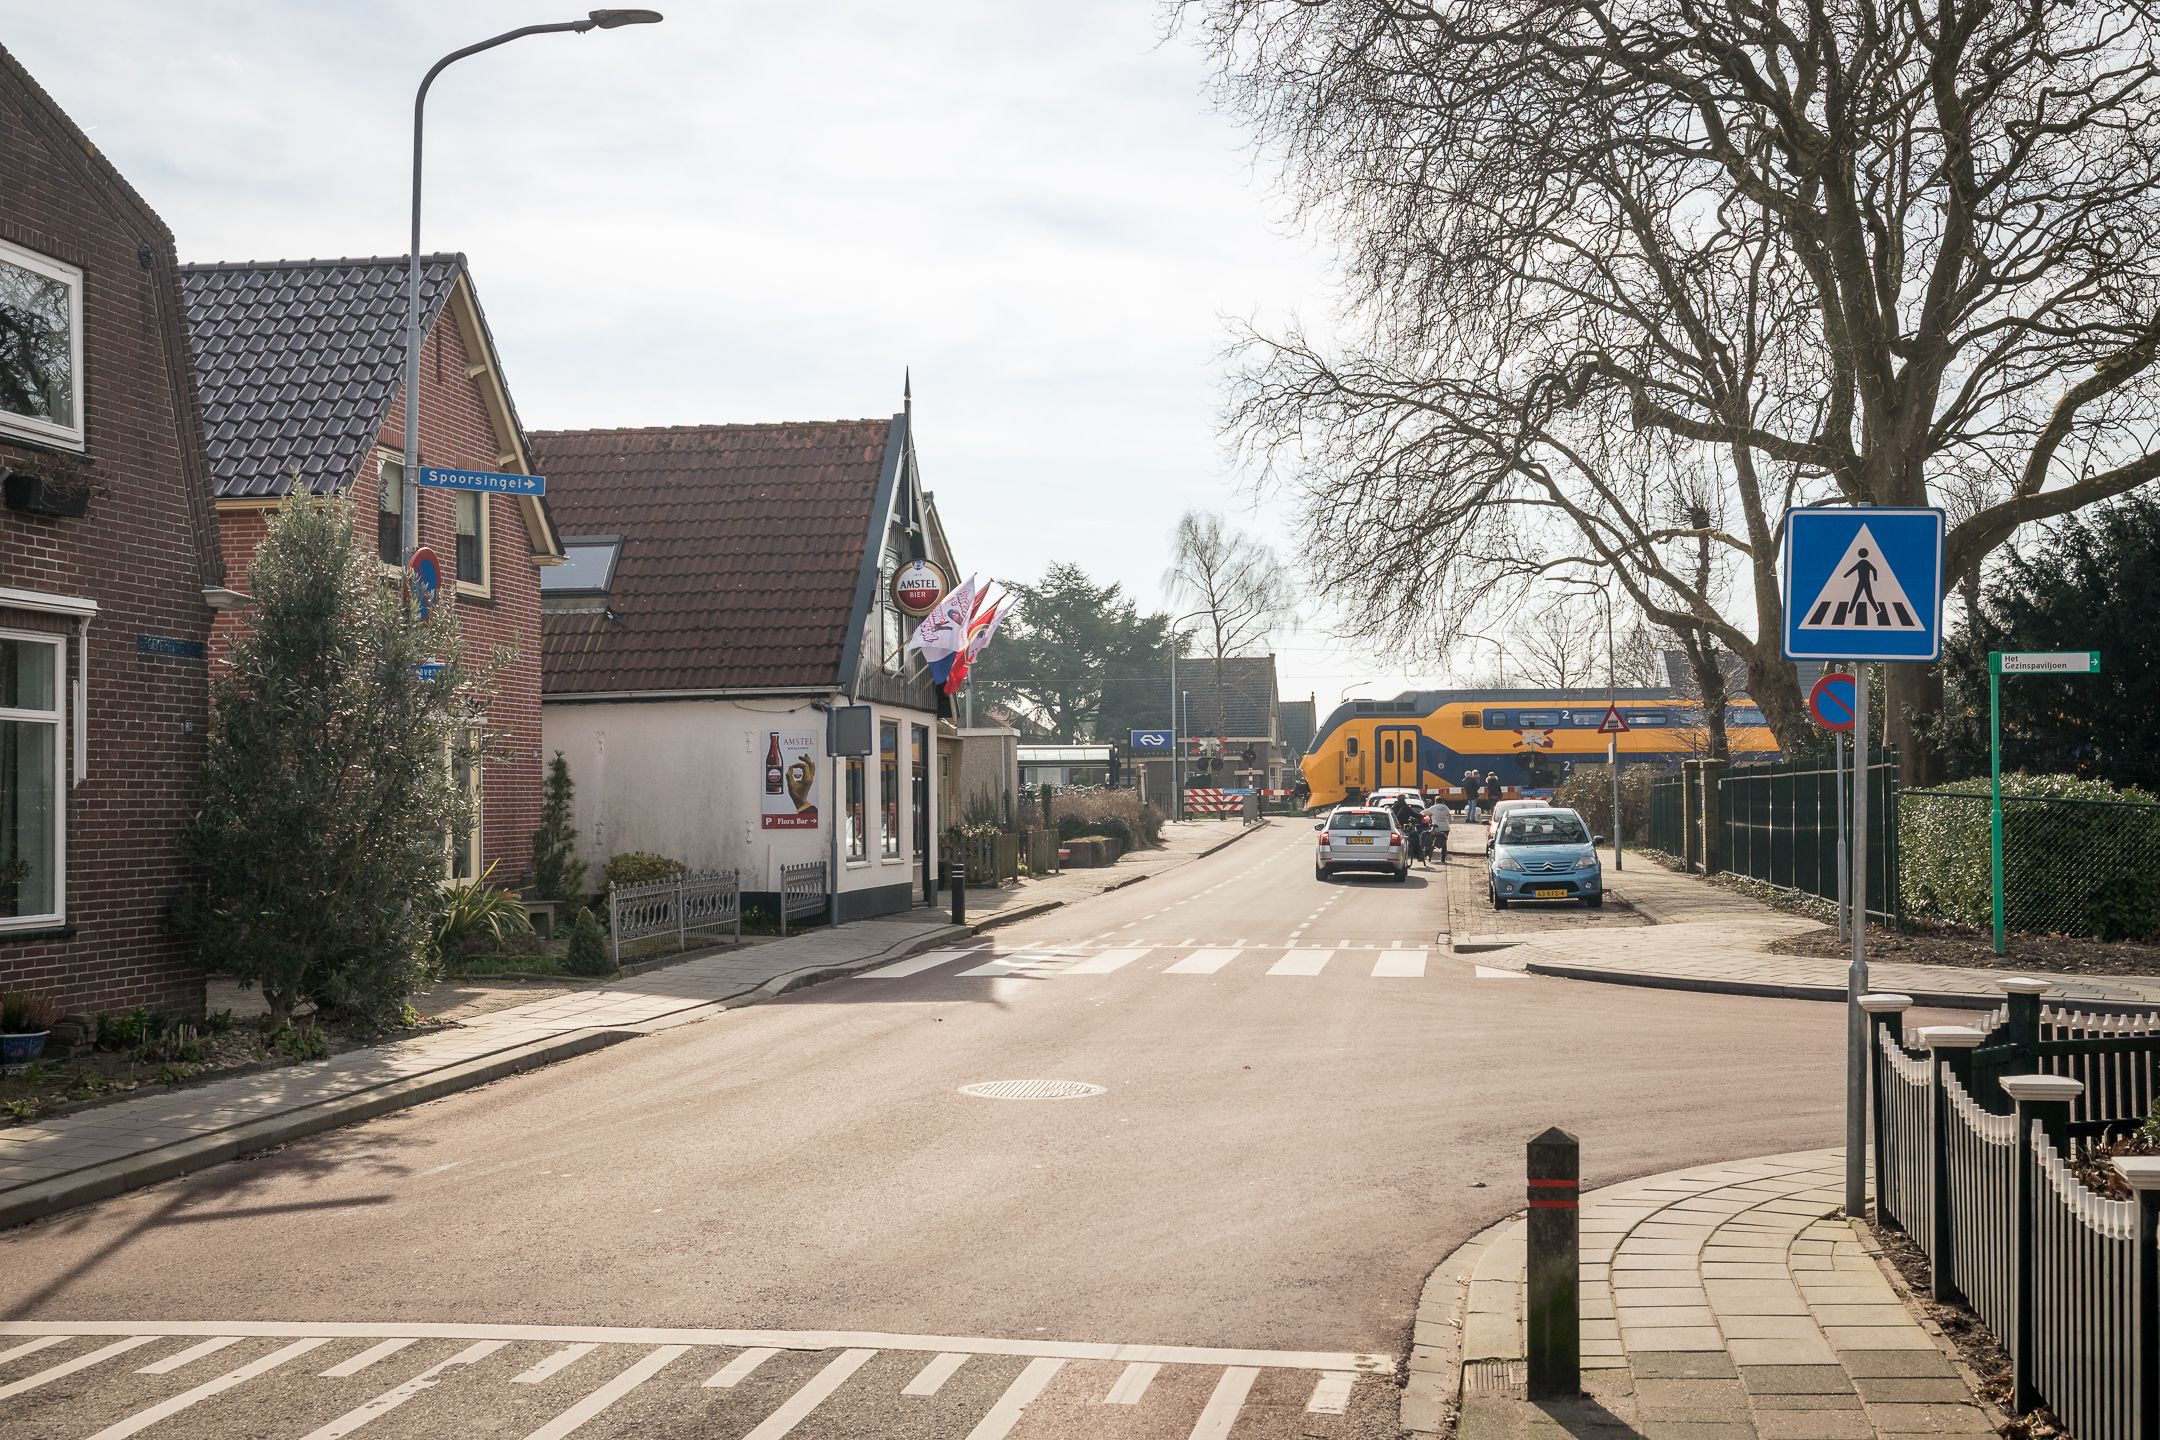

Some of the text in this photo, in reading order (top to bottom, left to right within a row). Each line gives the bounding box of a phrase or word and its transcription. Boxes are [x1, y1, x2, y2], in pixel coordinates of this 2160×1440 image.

[428, 470, 521, 490] Spoorsingel
[900, 579, 937, 589] AMSTEL
[2004, 662, 2067, 670] Gezinspaviljoen
[1562, 710, 1570, 720] 2
[1563, 761, 1571, 771] 2
[765, 817, 773, 825] P
